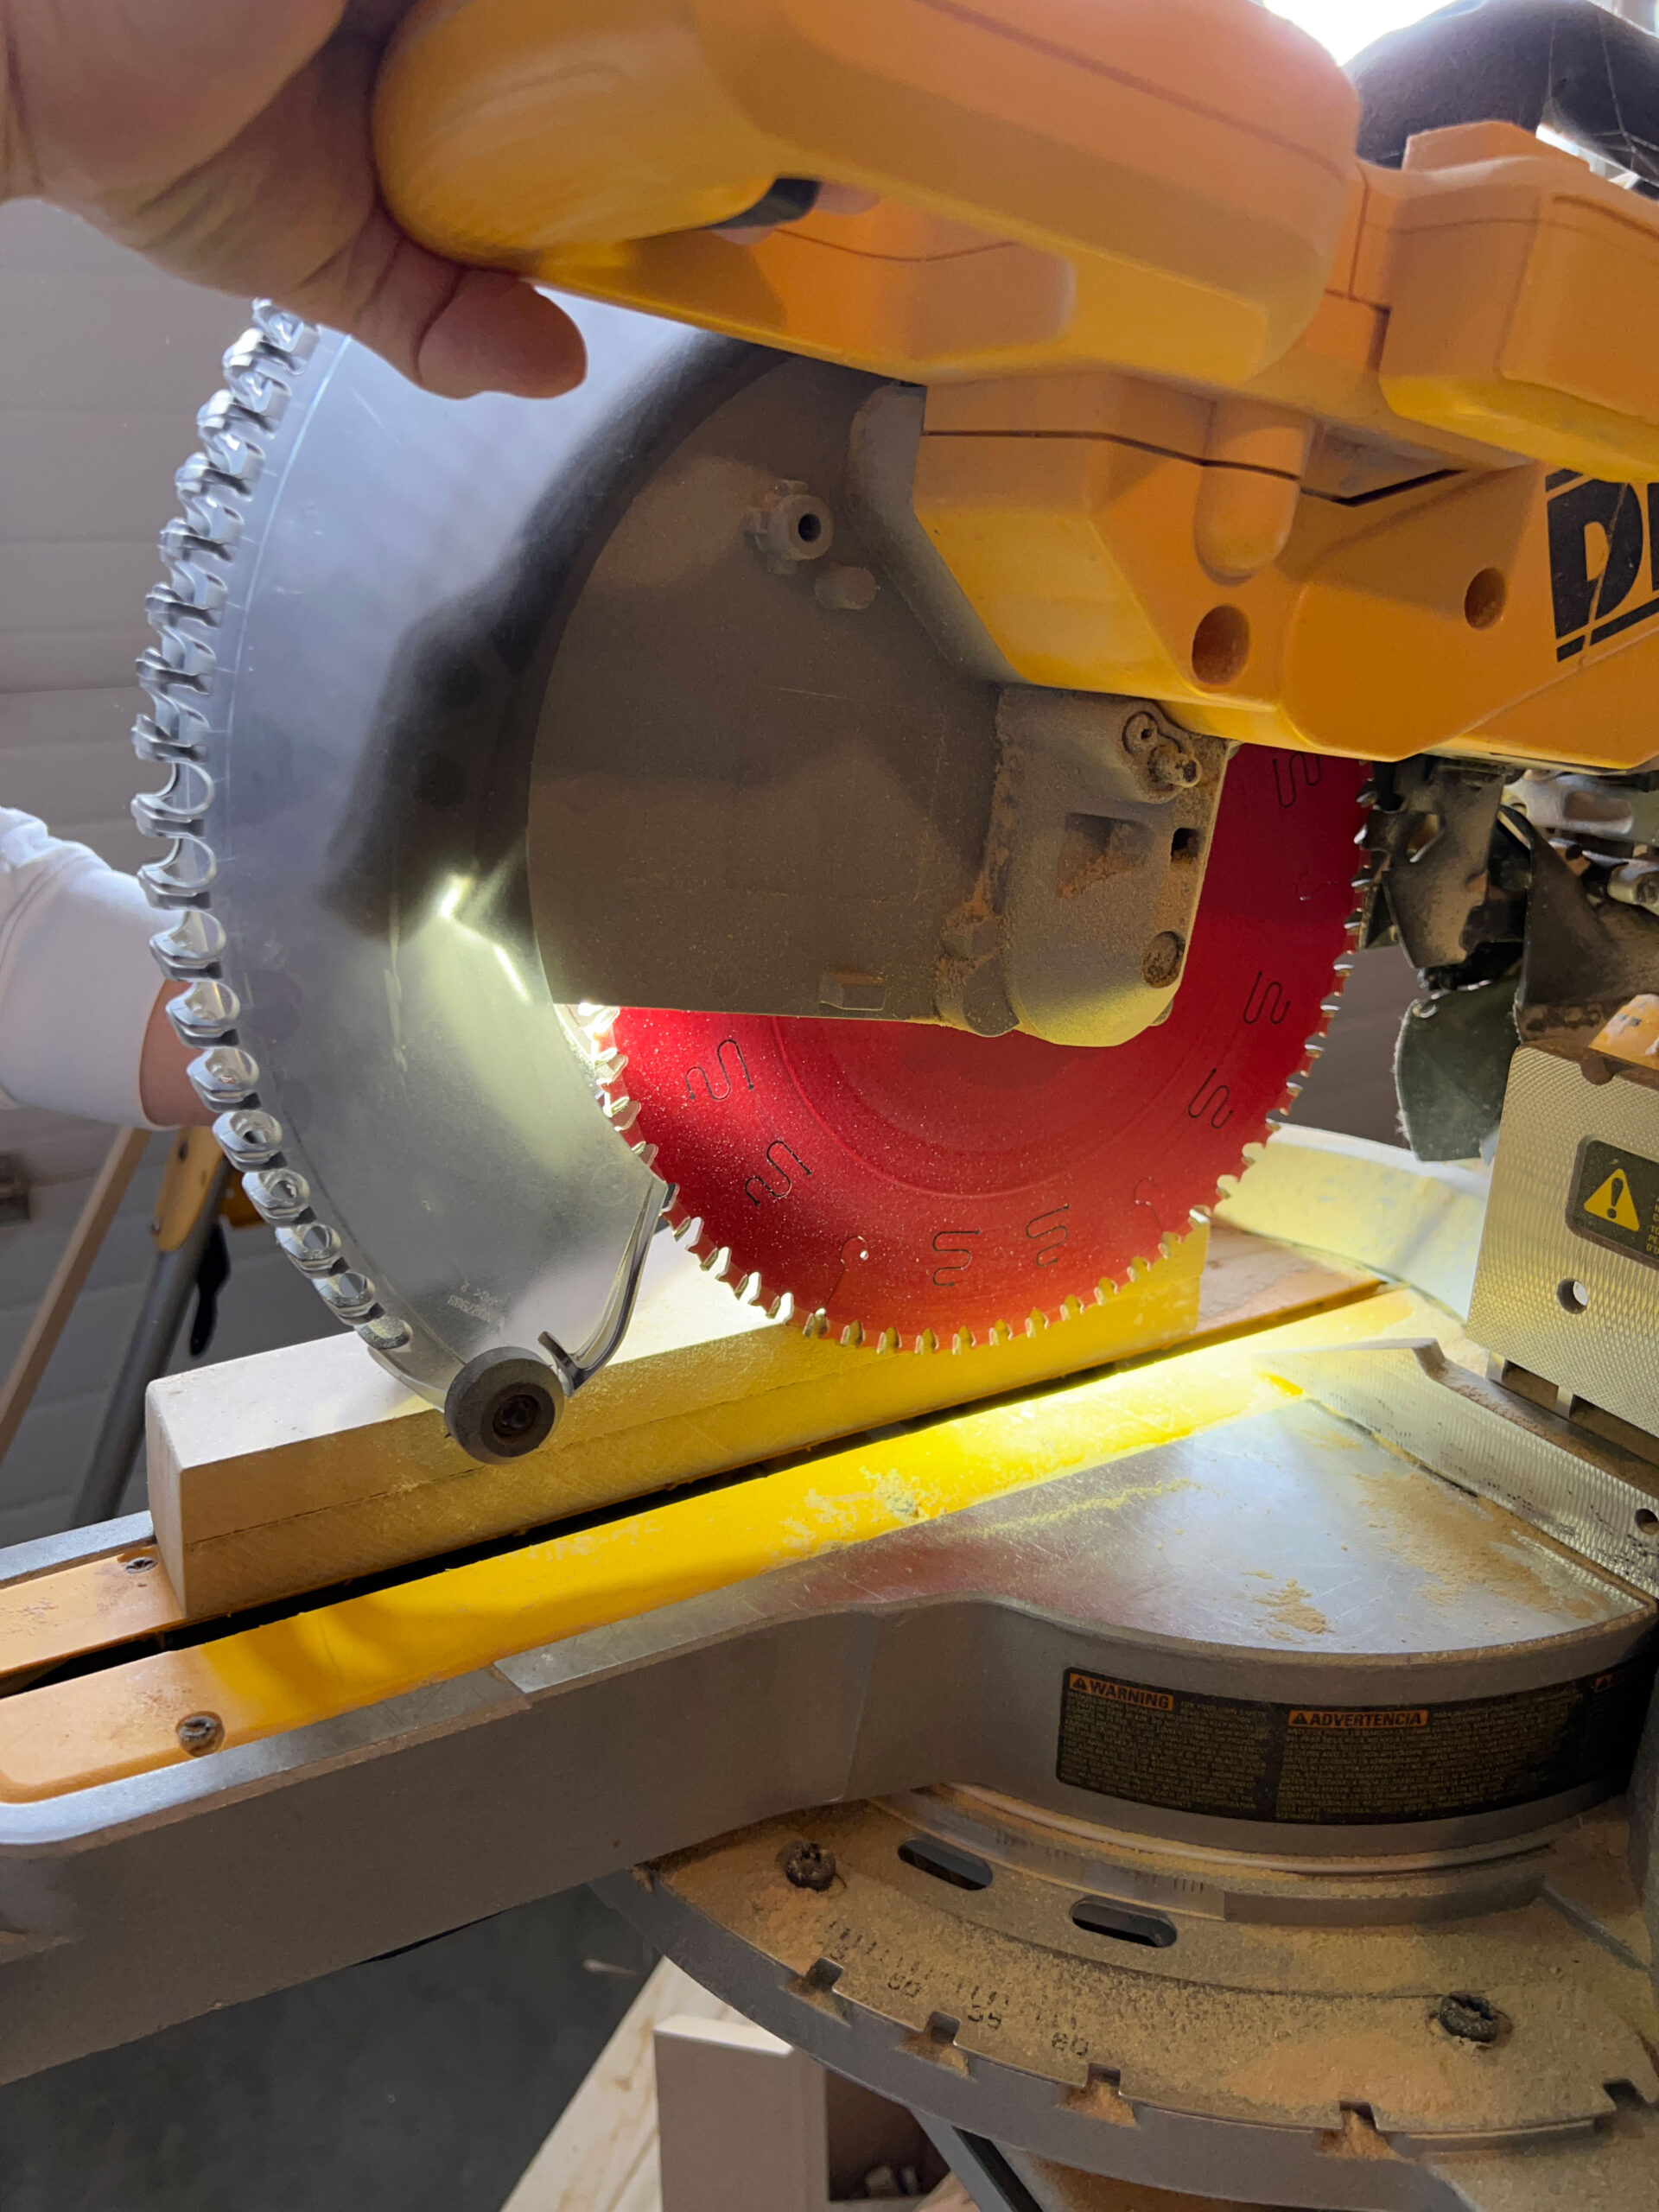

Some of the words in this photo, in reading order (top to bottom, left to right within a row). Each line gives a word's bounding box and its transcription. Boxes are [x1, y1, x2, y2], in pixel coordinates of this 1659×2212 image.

[1548, 480, 1659, 640] D
[1090, 1680, 1169, 1709] WARNING
[1310, 1712, 1421, 1726] ADVERTENCIA
